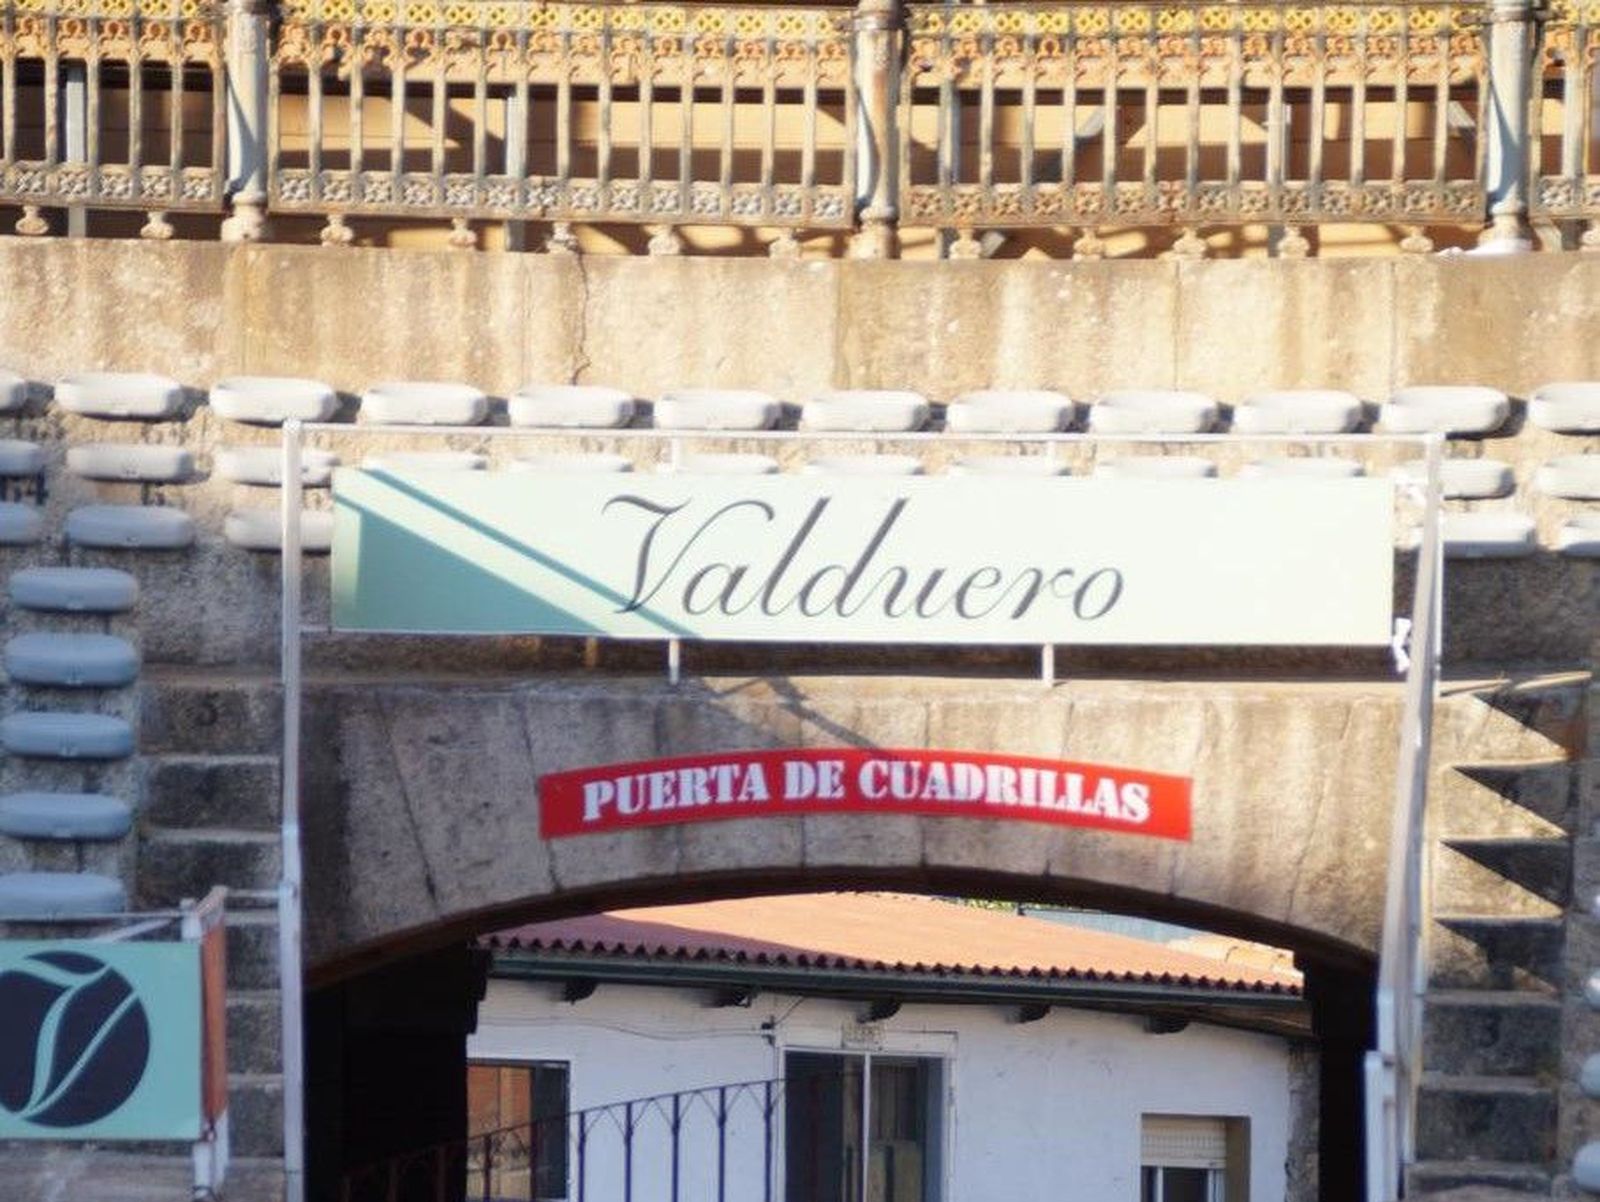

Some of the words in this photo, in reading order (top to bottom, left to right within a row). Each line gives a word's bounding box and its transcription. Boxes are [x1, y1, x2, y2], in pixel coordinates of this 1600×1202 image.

[602, 494, 1124, 620] Valduero
[583, 763, 769, 822] PUERTA
[784, 760, 845, 799] DE
[859, 760, 1151, 823] CUADRILLAS
